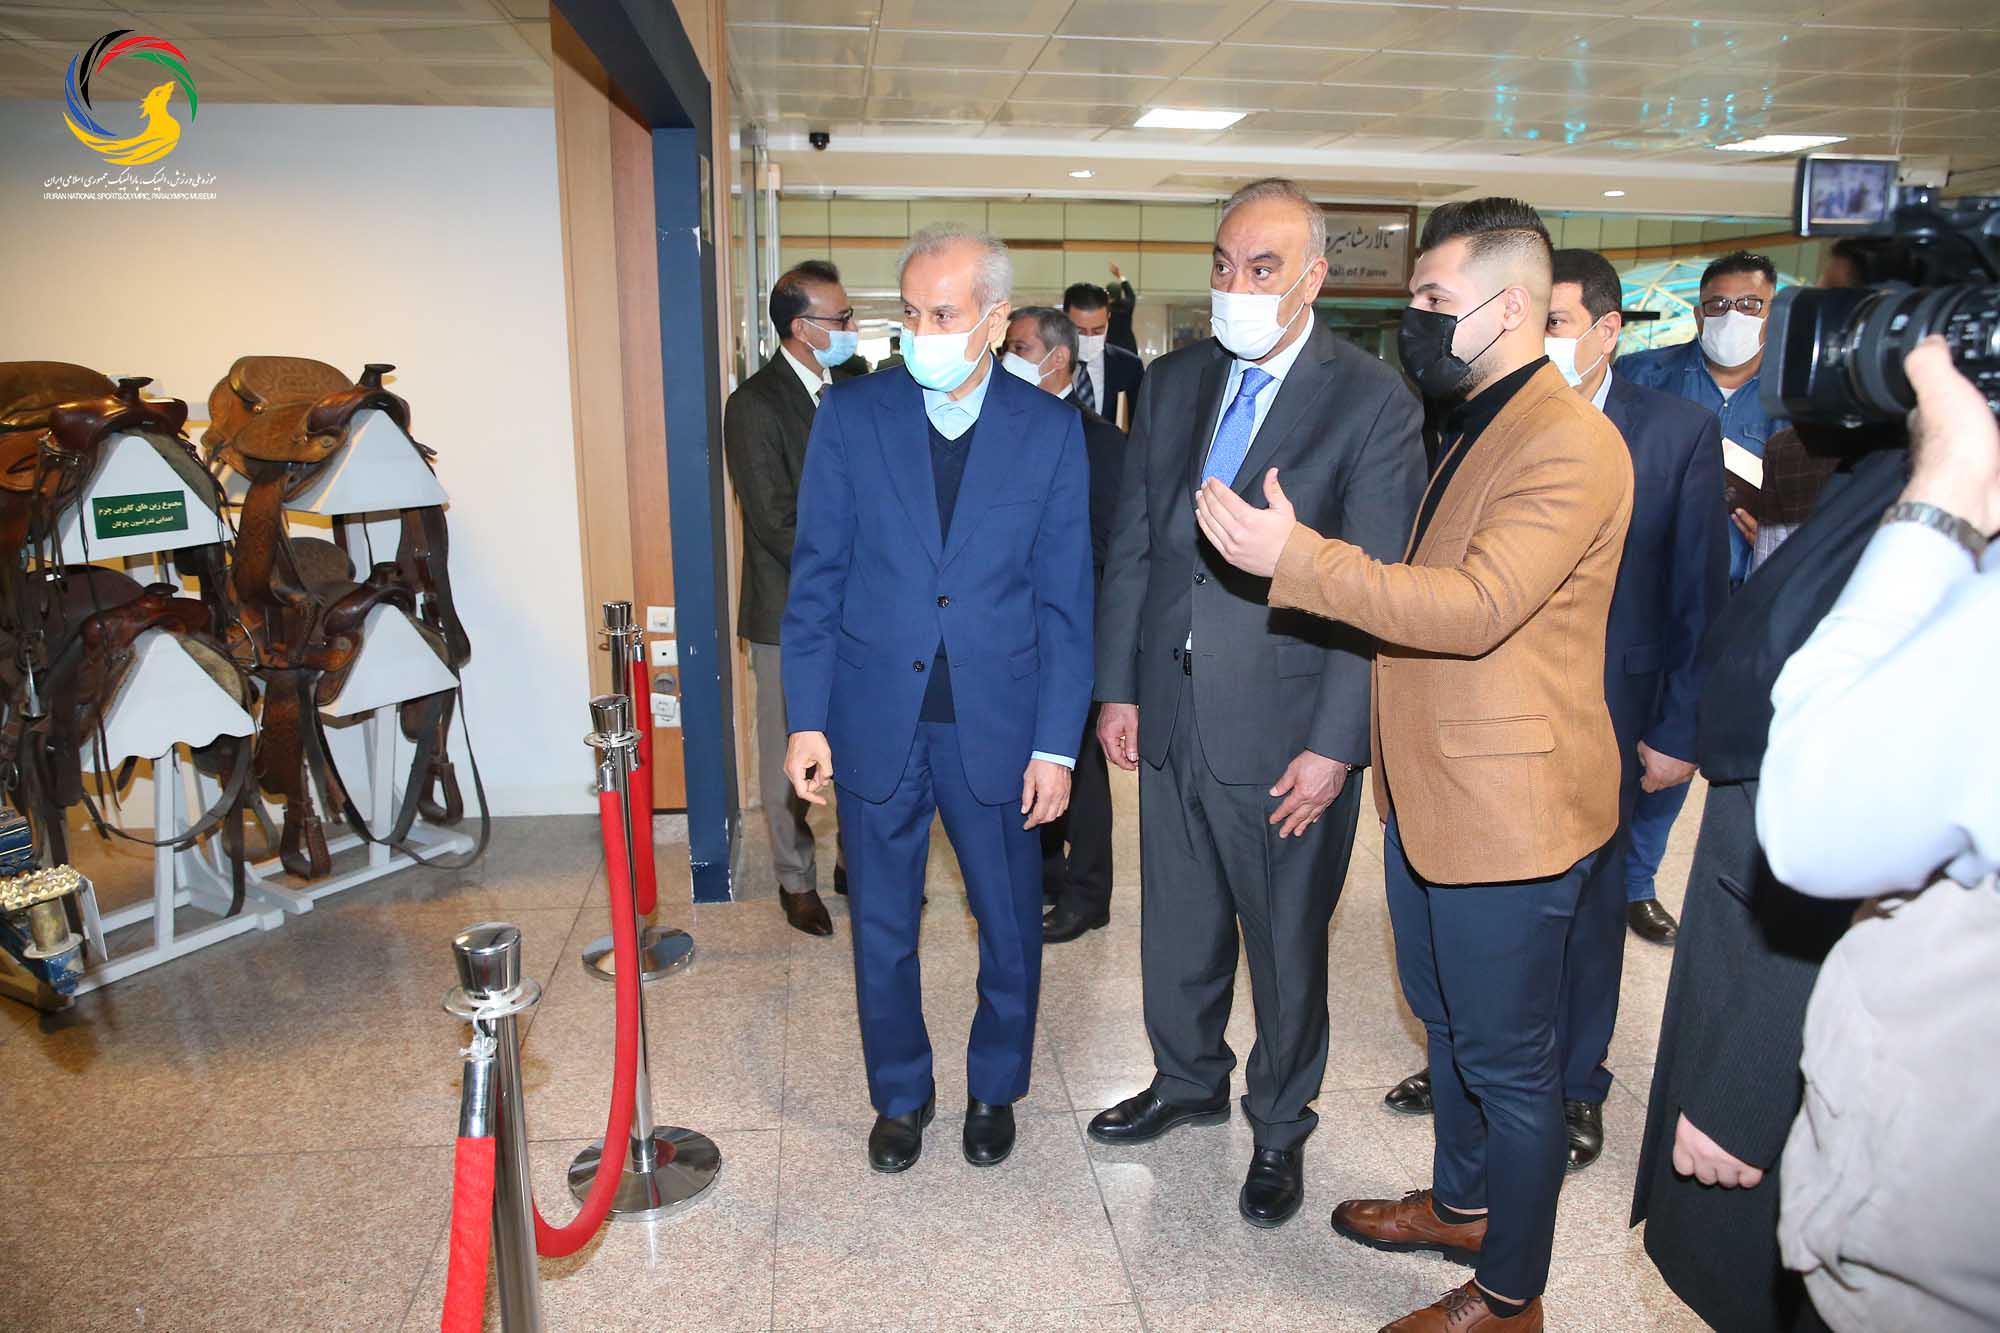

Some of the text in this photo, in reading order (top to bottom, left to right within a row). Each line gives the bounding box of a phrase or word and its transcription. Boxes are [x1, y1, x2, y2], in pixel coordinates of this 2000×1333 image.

[1346, 266, 1358, 277] of
[1360, 266, 1388, 277] Fame
[135, 502, 148, 513] های
